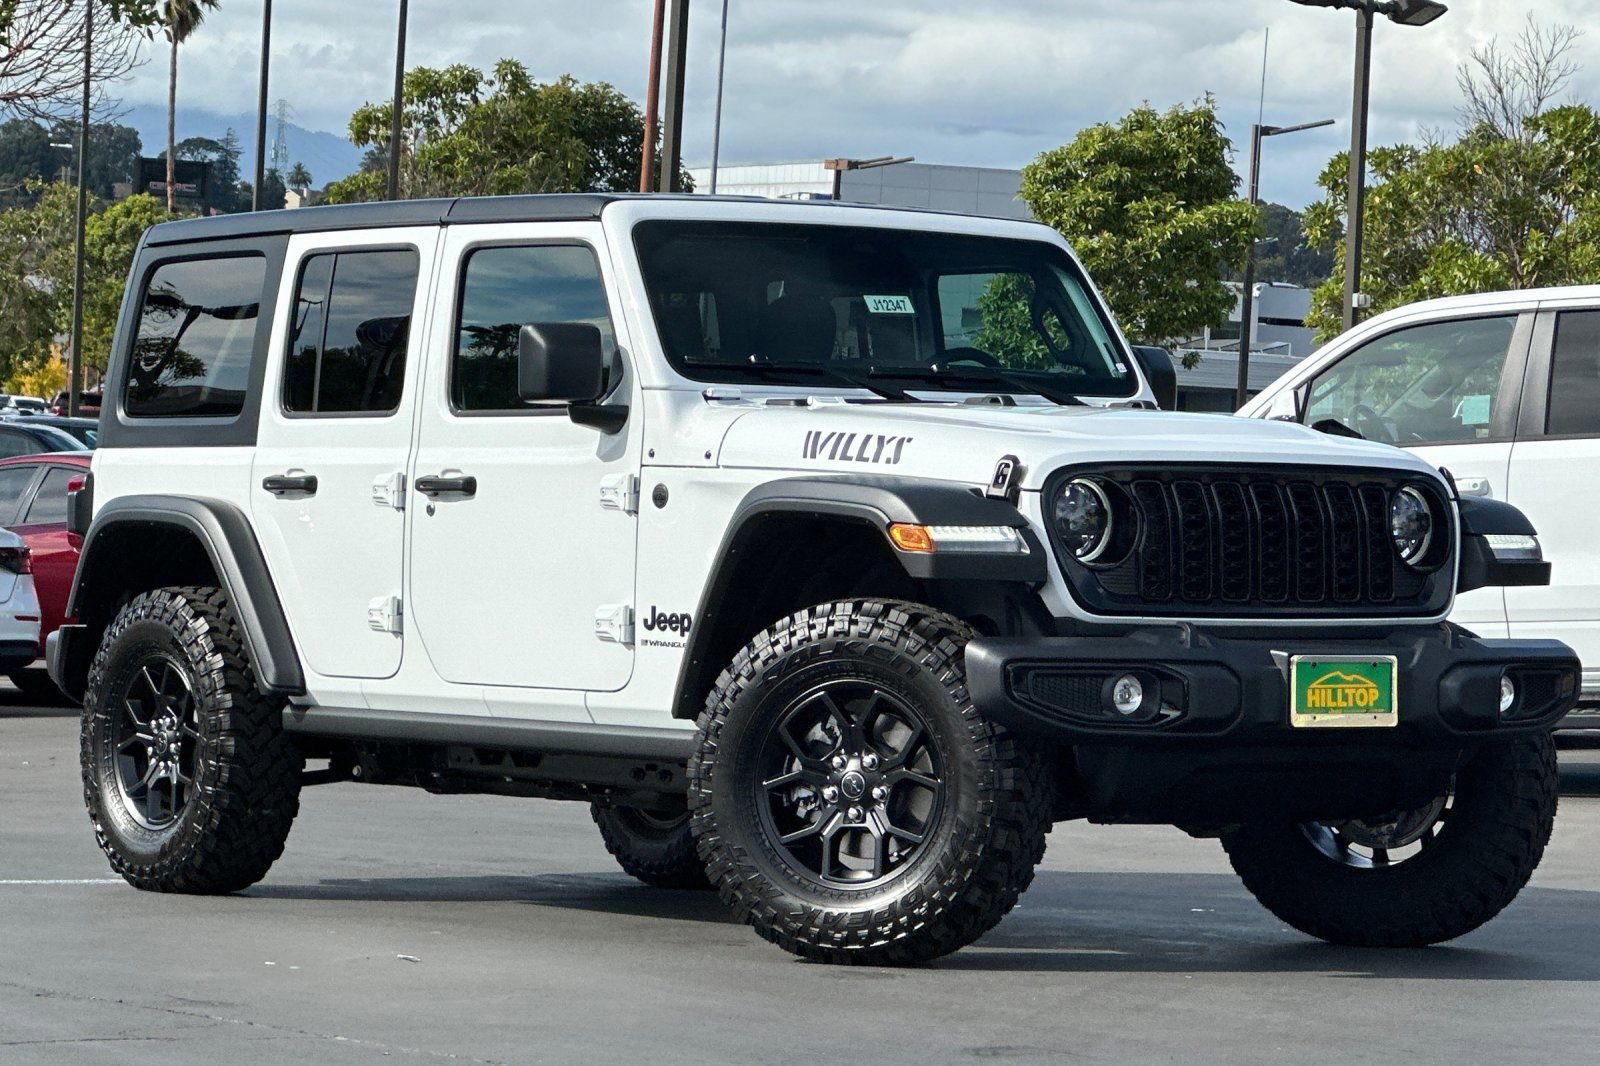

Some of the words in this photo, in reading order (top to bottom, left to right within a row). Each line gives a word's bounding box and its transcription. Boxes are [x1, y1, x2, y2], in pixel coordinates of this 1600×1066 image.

[873, 299, 907, 311] J12347
[802, 430, 914, 465] WILLYS
[643, 605, 692, 637] Jeep
[1306, 688, 1379, 707] HILLTOP
